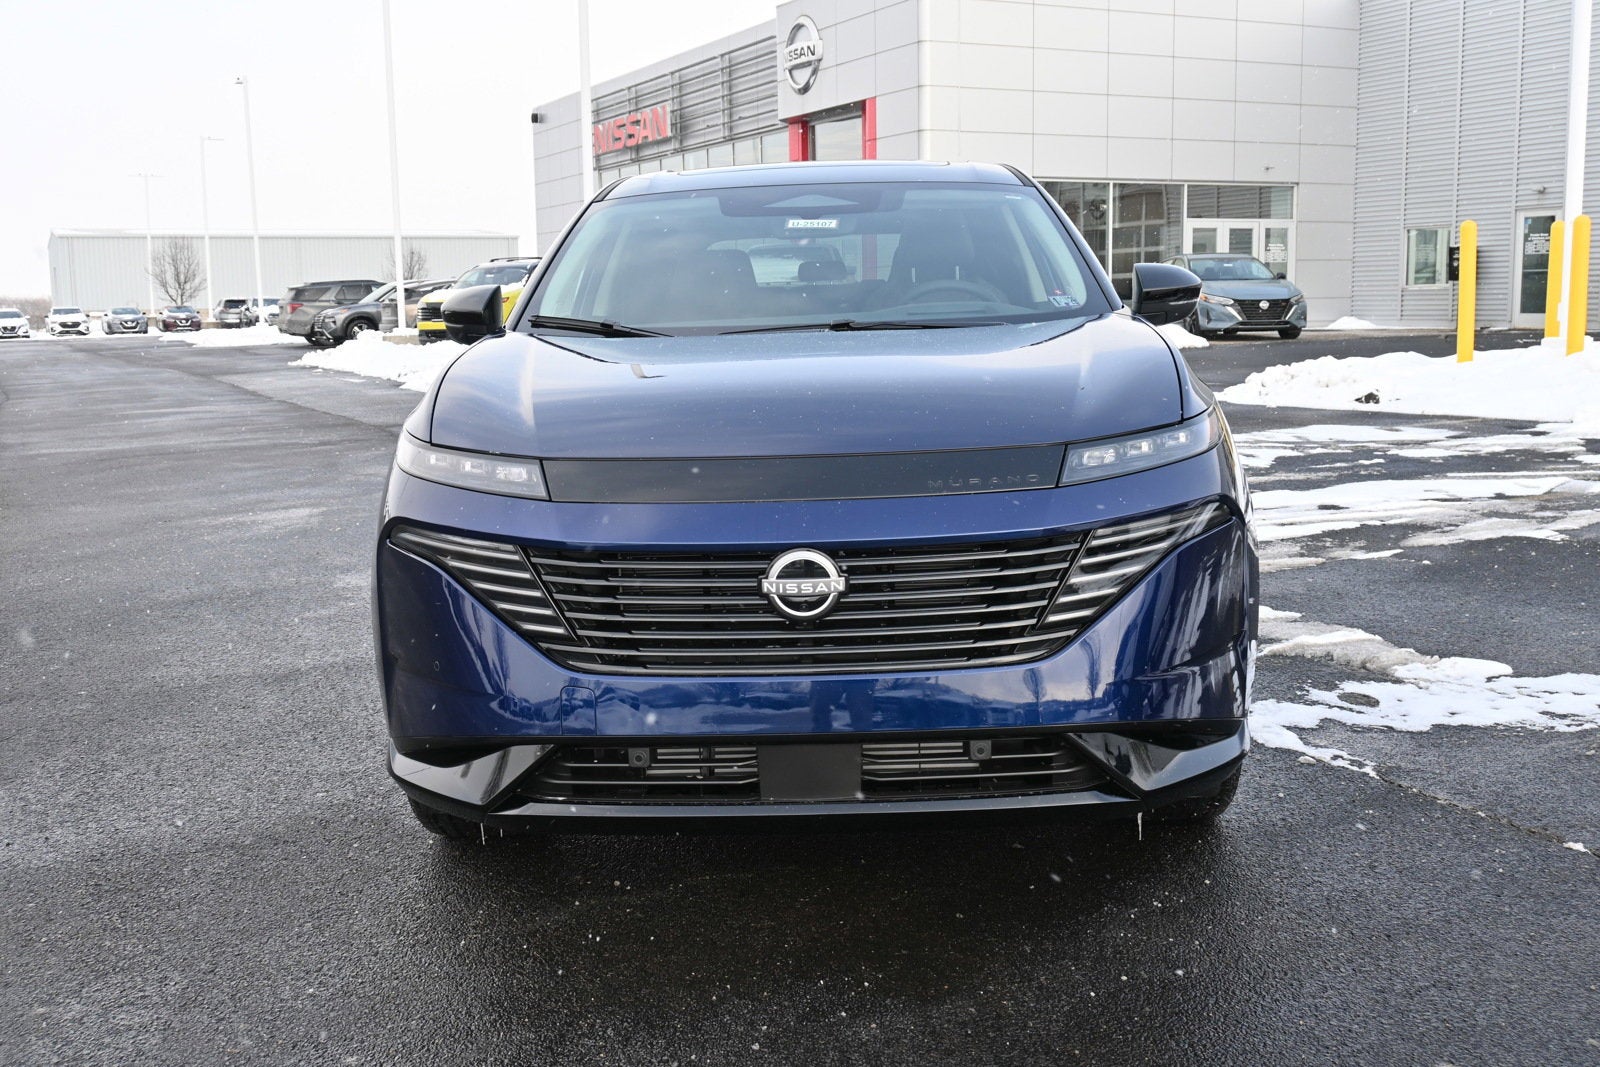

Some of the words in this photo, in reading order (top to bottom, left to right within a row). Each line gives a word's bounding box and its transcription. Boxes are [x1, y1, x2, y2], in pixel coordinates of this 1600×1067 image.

[594, 104, 668, 153] NISSAN
[927, 474, 1040, 489] MURANO
[763, 581, 844, 594] NISSAN
